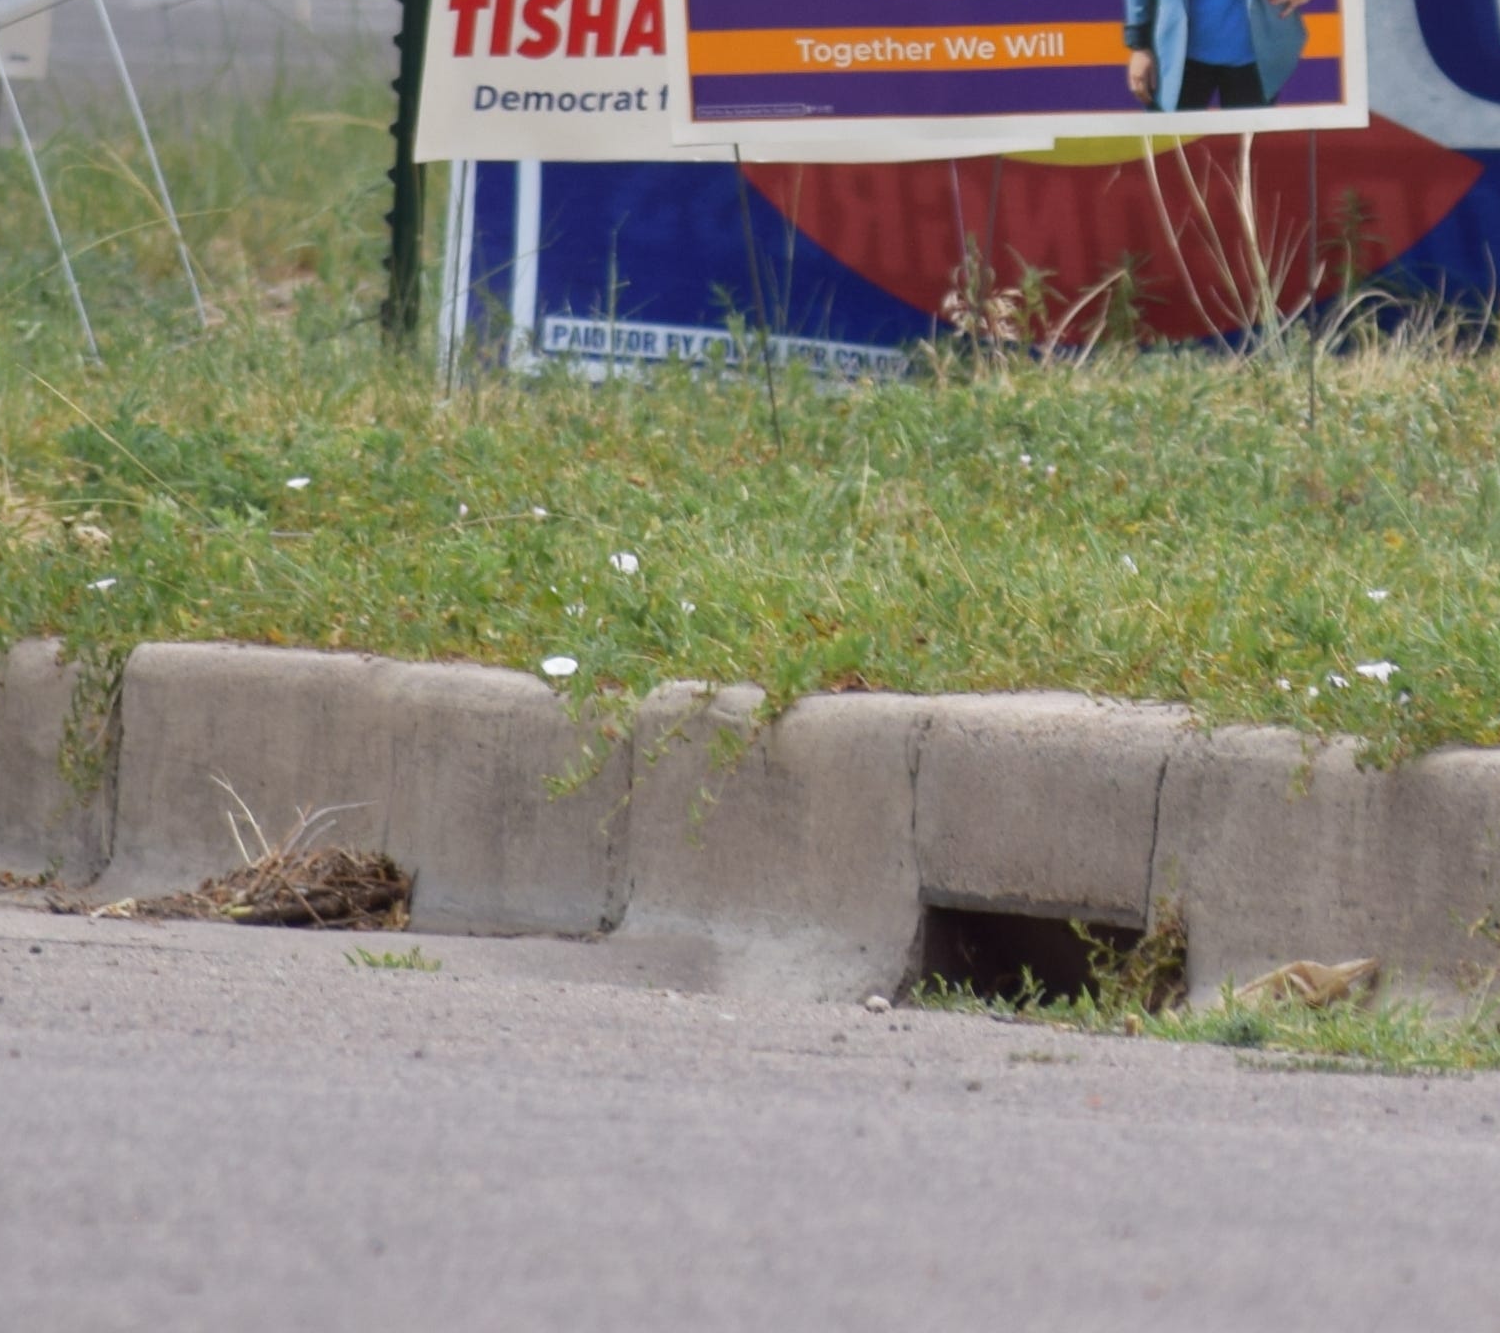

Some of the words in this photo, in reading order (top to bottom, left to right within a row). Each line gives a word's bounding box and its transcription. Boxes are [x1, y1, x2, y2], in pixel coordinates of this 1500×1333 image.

[796, 37, 936, 68] Together
[943, 36, 997, 61] We
[1004, 32, 1066, 58] Will
[473, 84, 649, 113] Democrat
[553, 323, 606, 351] PAID
[616, 329, 656, 353] FOR
